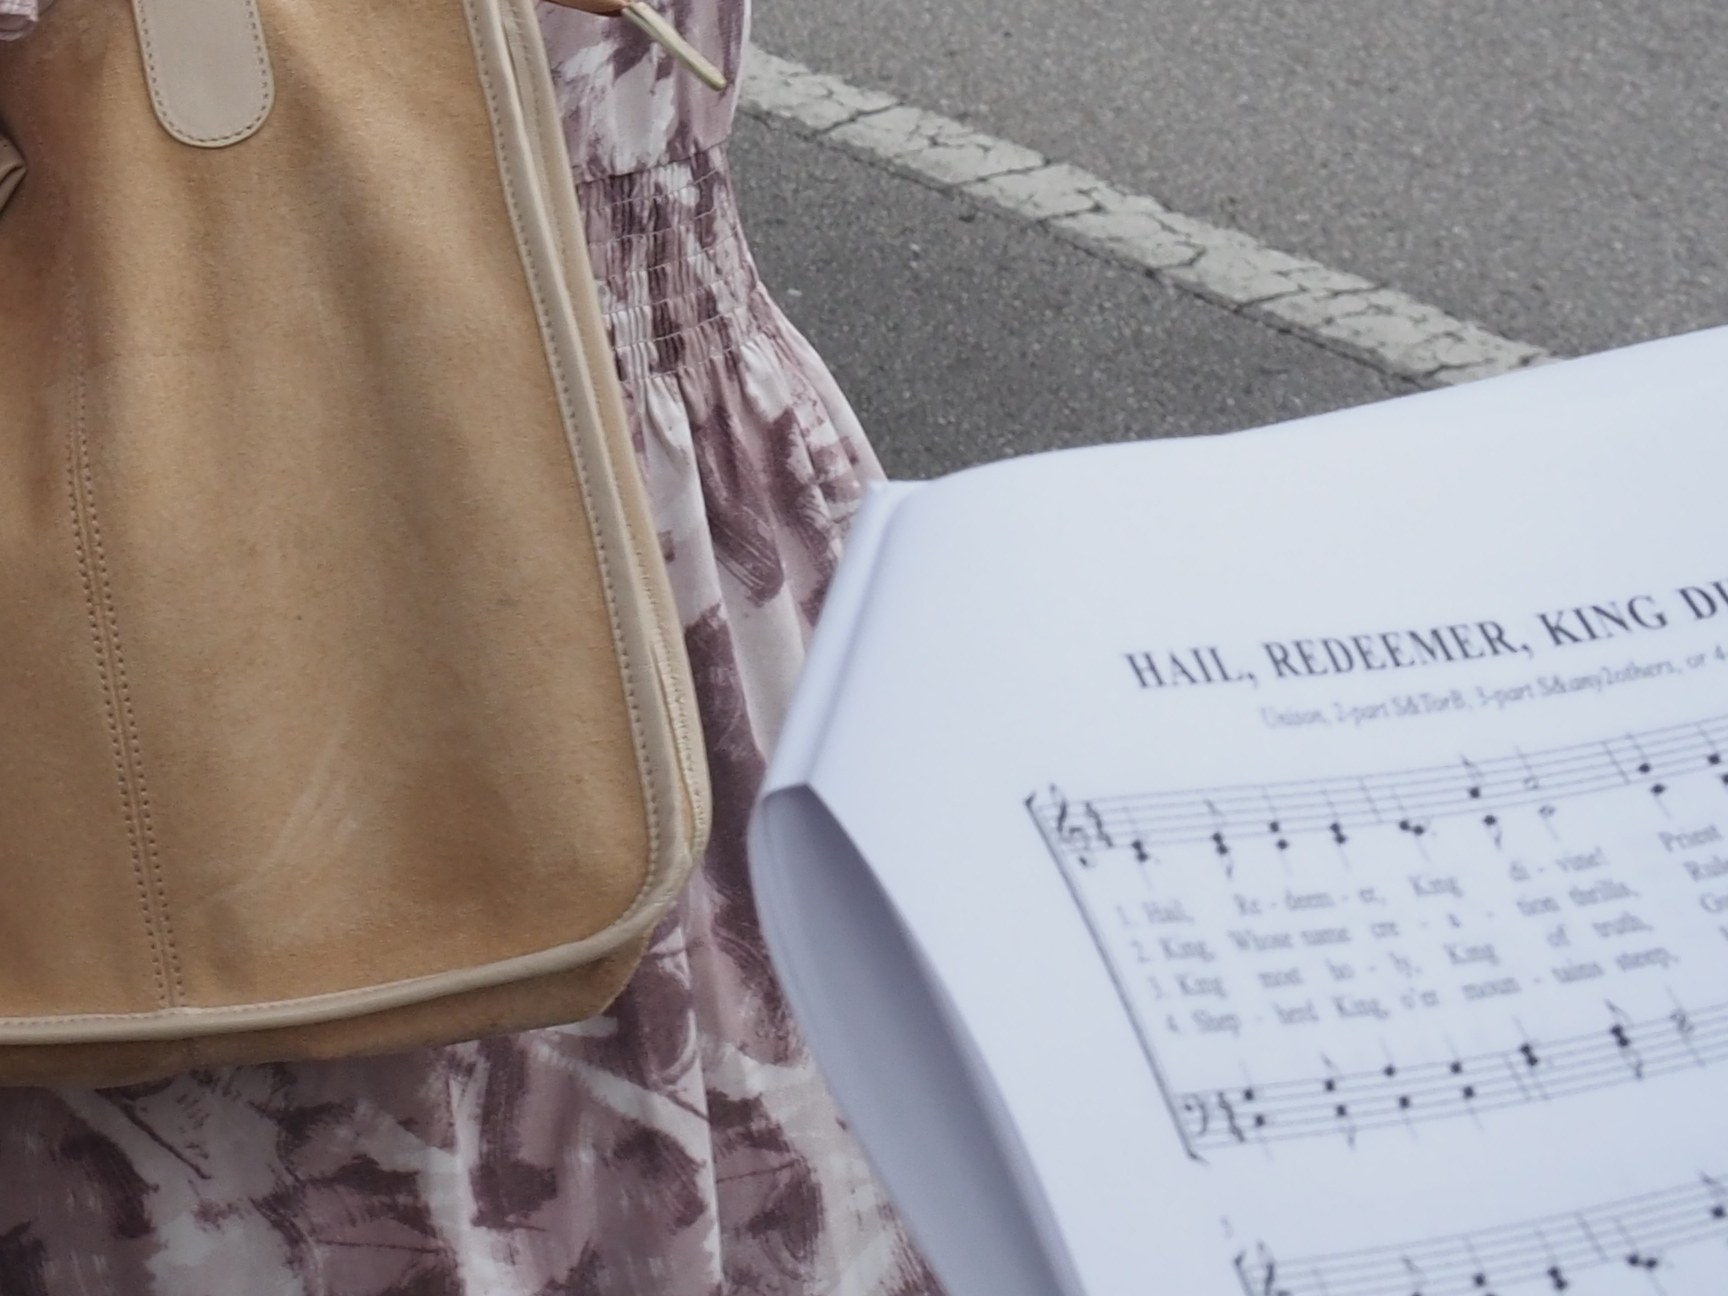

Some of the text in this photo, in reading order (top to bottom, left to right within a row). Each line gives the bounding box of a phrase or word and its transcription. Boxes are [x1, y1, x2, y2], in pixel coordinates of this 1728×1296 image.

[1123, 577, 1728, 690] HAIL, REDEEMER, KING DI
[1408, 875, 1464, 898] King
